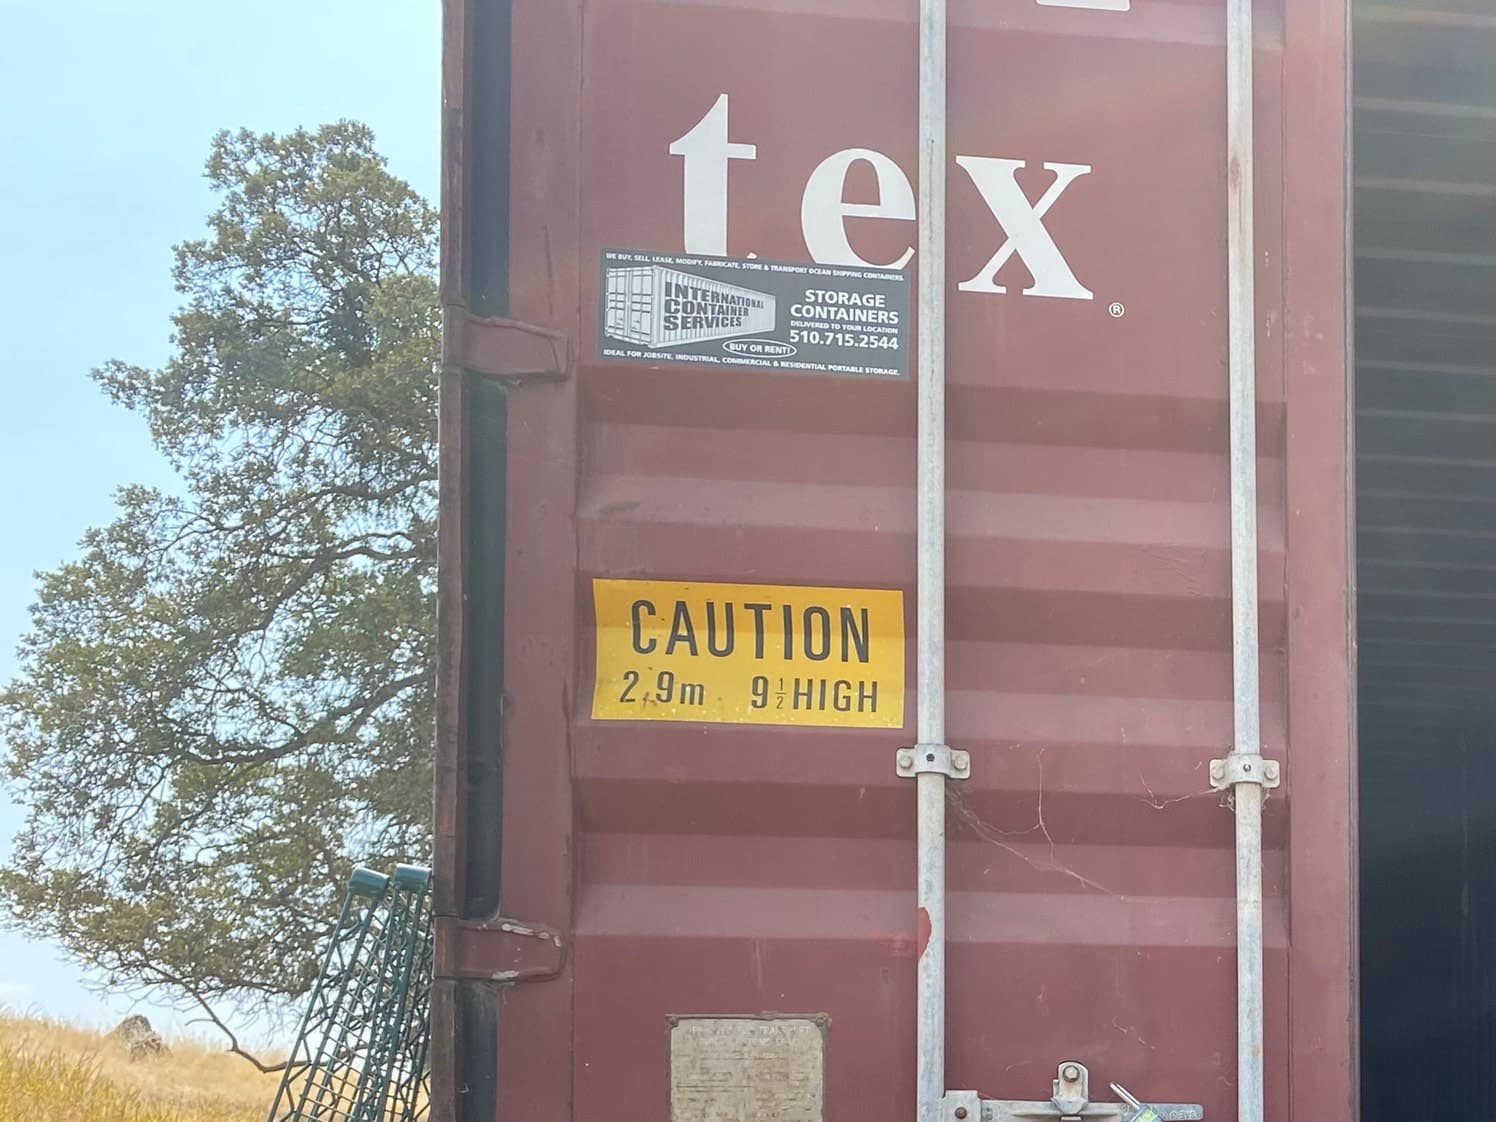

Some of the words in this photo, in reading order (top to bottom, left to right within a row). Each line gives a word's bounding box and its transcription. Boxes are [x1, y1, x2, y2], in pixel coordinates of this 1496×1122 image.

[670, 94, 1093, 299] tex
[606, 252, 617, 260] WE
[618, 253, 632, 261] BUY,
[634, 254, 650, 262] SELL,
[652, 255, 674, 263] LEASE,
[676, 257, 702, 266] MODIFY,
[705, 260, 740, 269] FABRICATE,
[771, 265, 807, 274] TRANSPORT
[809, 268, 831, 276] OCEAN
[833, 270, 862, 278] SHIPPING
[665, 282, 764, 308] INTERNATIONAL
[805, 289, 885, 307] STORAGE
[664, 299, 749, 317] CONTAINER
[791, 304, 899, 324] CONTAINERS
[664, 315, 742, 331] SERVICES
[791, 320, 829, 329] DELIVERED
[831, 322, 840, 330] TO
[842, 323, 862, 331] YOUR
[863, 325, 898, 333] LOCATION
[730, 343, 748, 351] BUY
[750, 344, 762, 352] OR
[765, 345, 790, 354] RENT!
[790, 330, 899, 350] 510.715.2544
[604, 349, 625, 357] IDEAL
[627, 350, 641, 358] FOR
[643, 351, 674, 360] JOBSITE,
[722, 357, 771, 367] COMMERCIAL
[781, 361, 826, 370] RESIDENTIAL
[828, 364, 863, 373] PORTABLE
[865, 367, 900, 376] STORAGE.
[631, 600, 869, 663] CAUTION
[793, 677, 877, 713] HIGH
